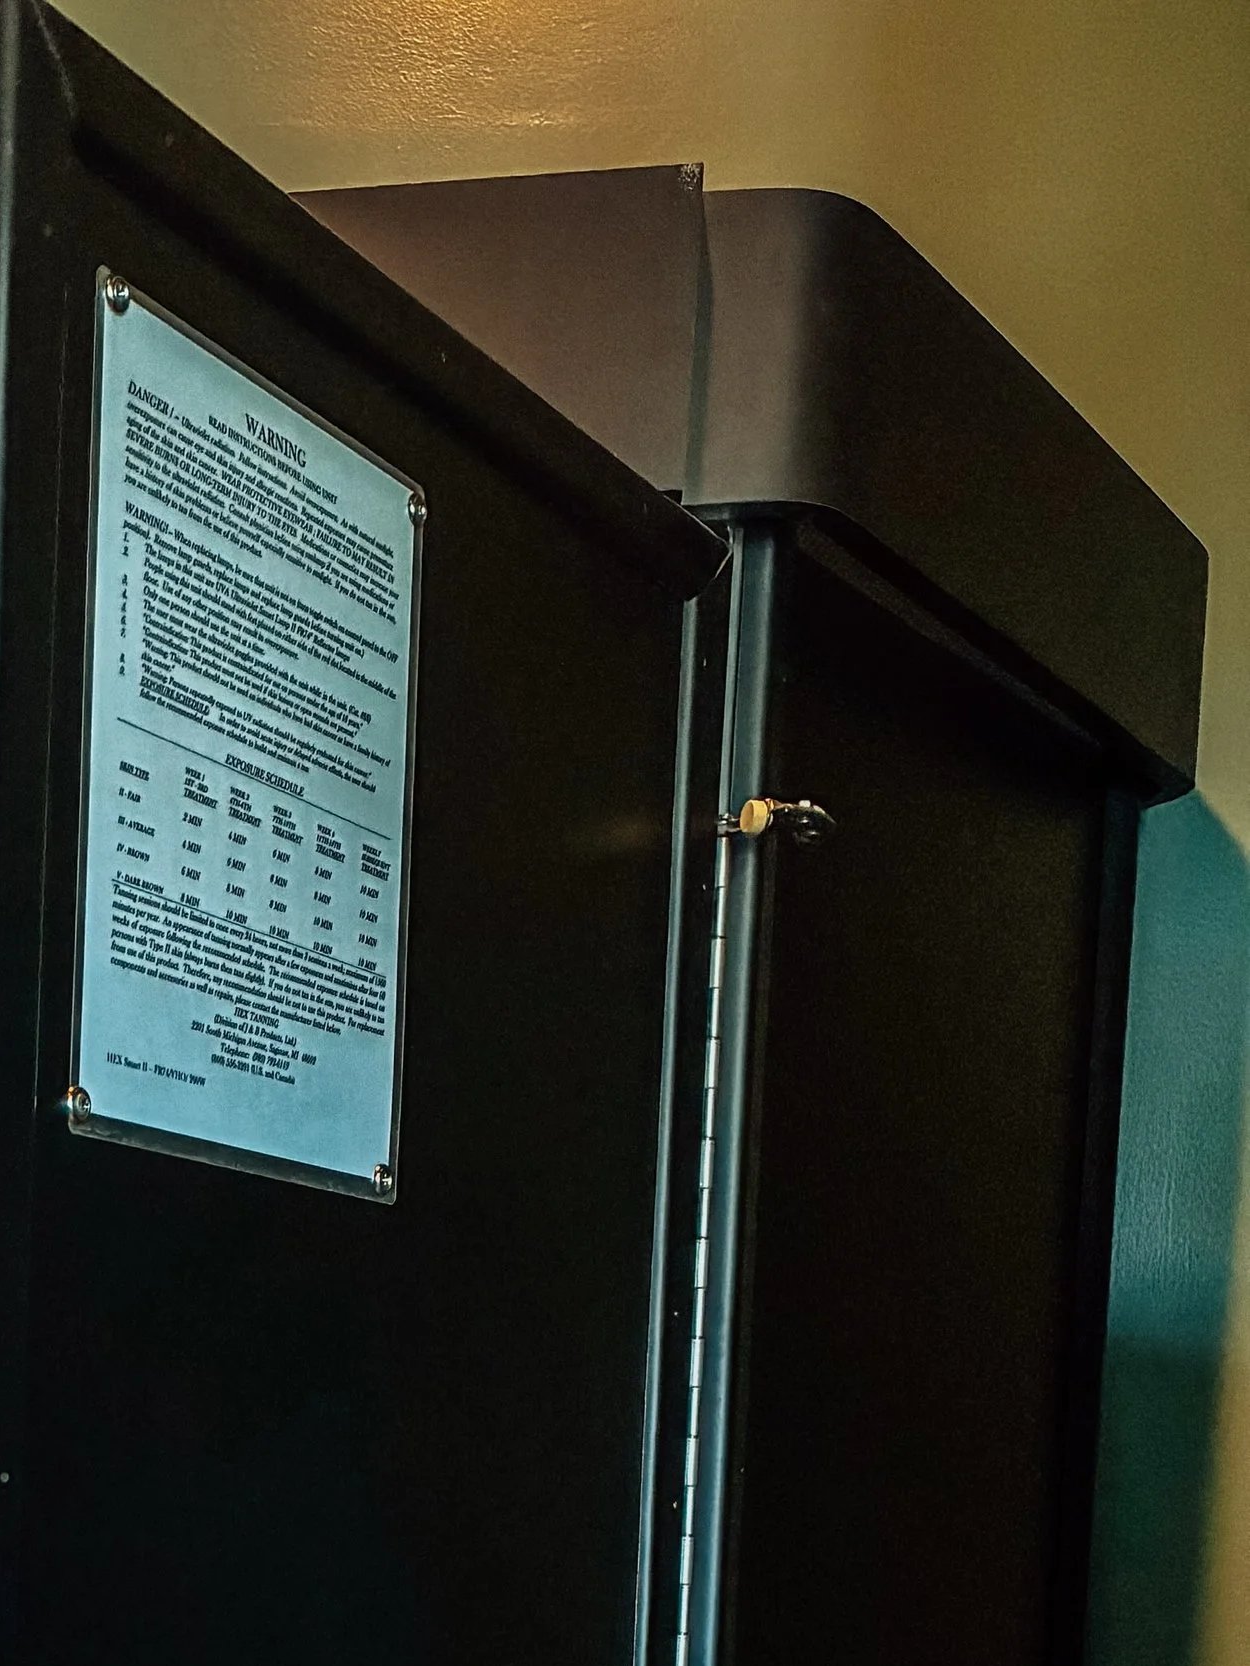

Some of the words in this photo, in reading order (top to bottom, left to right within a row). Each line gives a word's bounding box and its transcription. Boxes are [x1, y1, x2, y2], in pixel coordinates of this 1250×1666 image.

[127, 378, 170, 416] DANGER
[244, 412, 307, 469] WARNING
[124, 499, 170, 535] WARNING!
[224, 752, 266, 781] EXPOSURE
[264, 771, 306, 798] SCHEDULE
[186, 813, 204, 828] MIN
[231, 832, 248, 846] MIN
[185, 840, 202, 855] MIN
[275, 849, 291, 864] MIN
[229, 858, 247, 873] MIN
[184, 867, 202, 882] MIN
[273, 874, 289, 889] MIN
[317, 867, 333, 881] MIN
[229, 884, 246, 899] MIN
[317, 891, 332, 906] MIN
[365, 886, 380, 900] MIN
[185, 893, 201, 909] MIN
[272, 900, 288, 914] MIN
[232, 911, 249, 925] MIN
[319, 917, 334, 932] MIN
[364, 910, 379, 924] MIN
[275, 926, 290, 940] MIN
[364, 934, 378, 948] MIN
[318, 943, 334, 955] MIN
[363, 959, 378, 972] MIN
